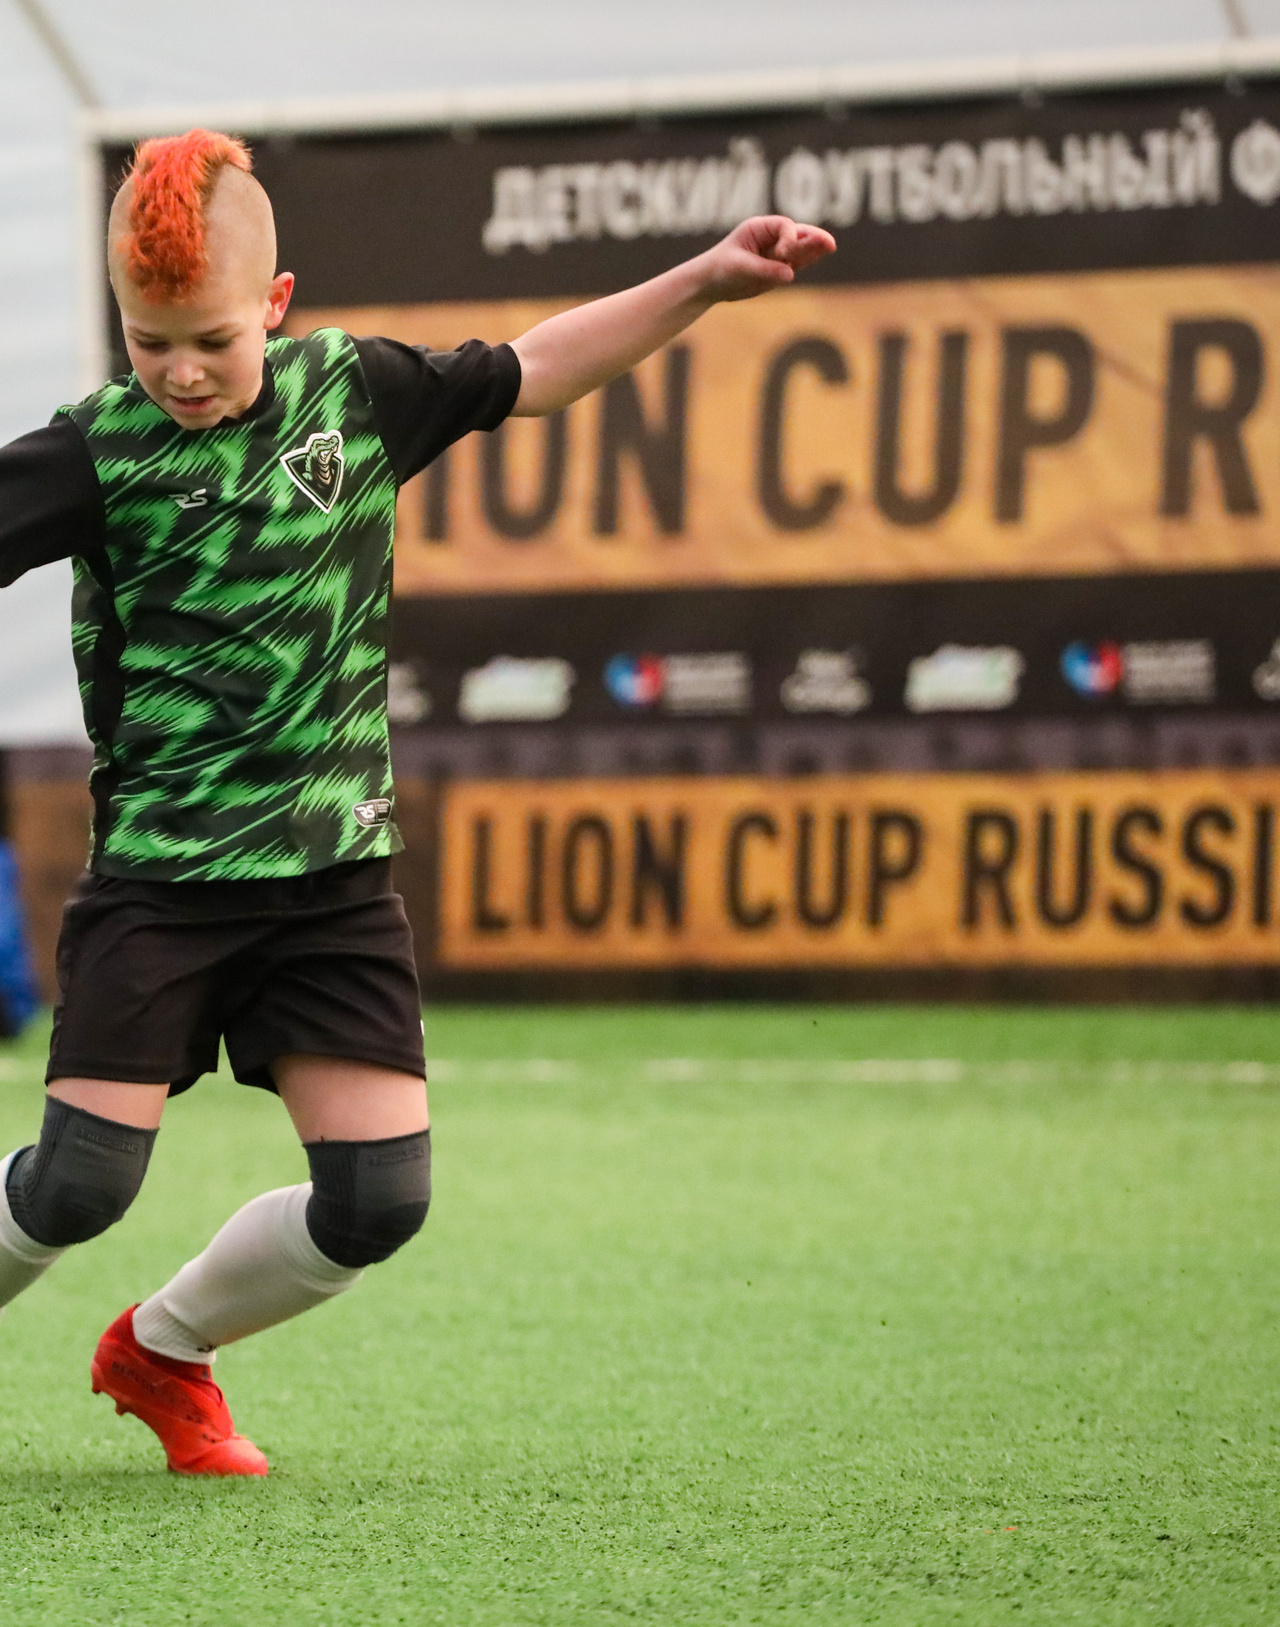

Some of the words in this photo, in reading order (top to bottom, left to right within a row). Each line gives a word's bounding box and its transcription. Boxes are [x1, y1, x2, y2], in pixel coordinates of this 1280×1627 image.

[483, 138, 769, 254] ДЕТСКИЙ
[774, 108, 1220, 228] ФУТБОЛЬНЫЙ
[756, 324, 1098, 532] CUP
[1160, 314, 1265, 518] R
[471, 808, 689, 932] LION
[725, 808, 924, 930] CUP
[960, 804, 1273, 930] RUSSI
